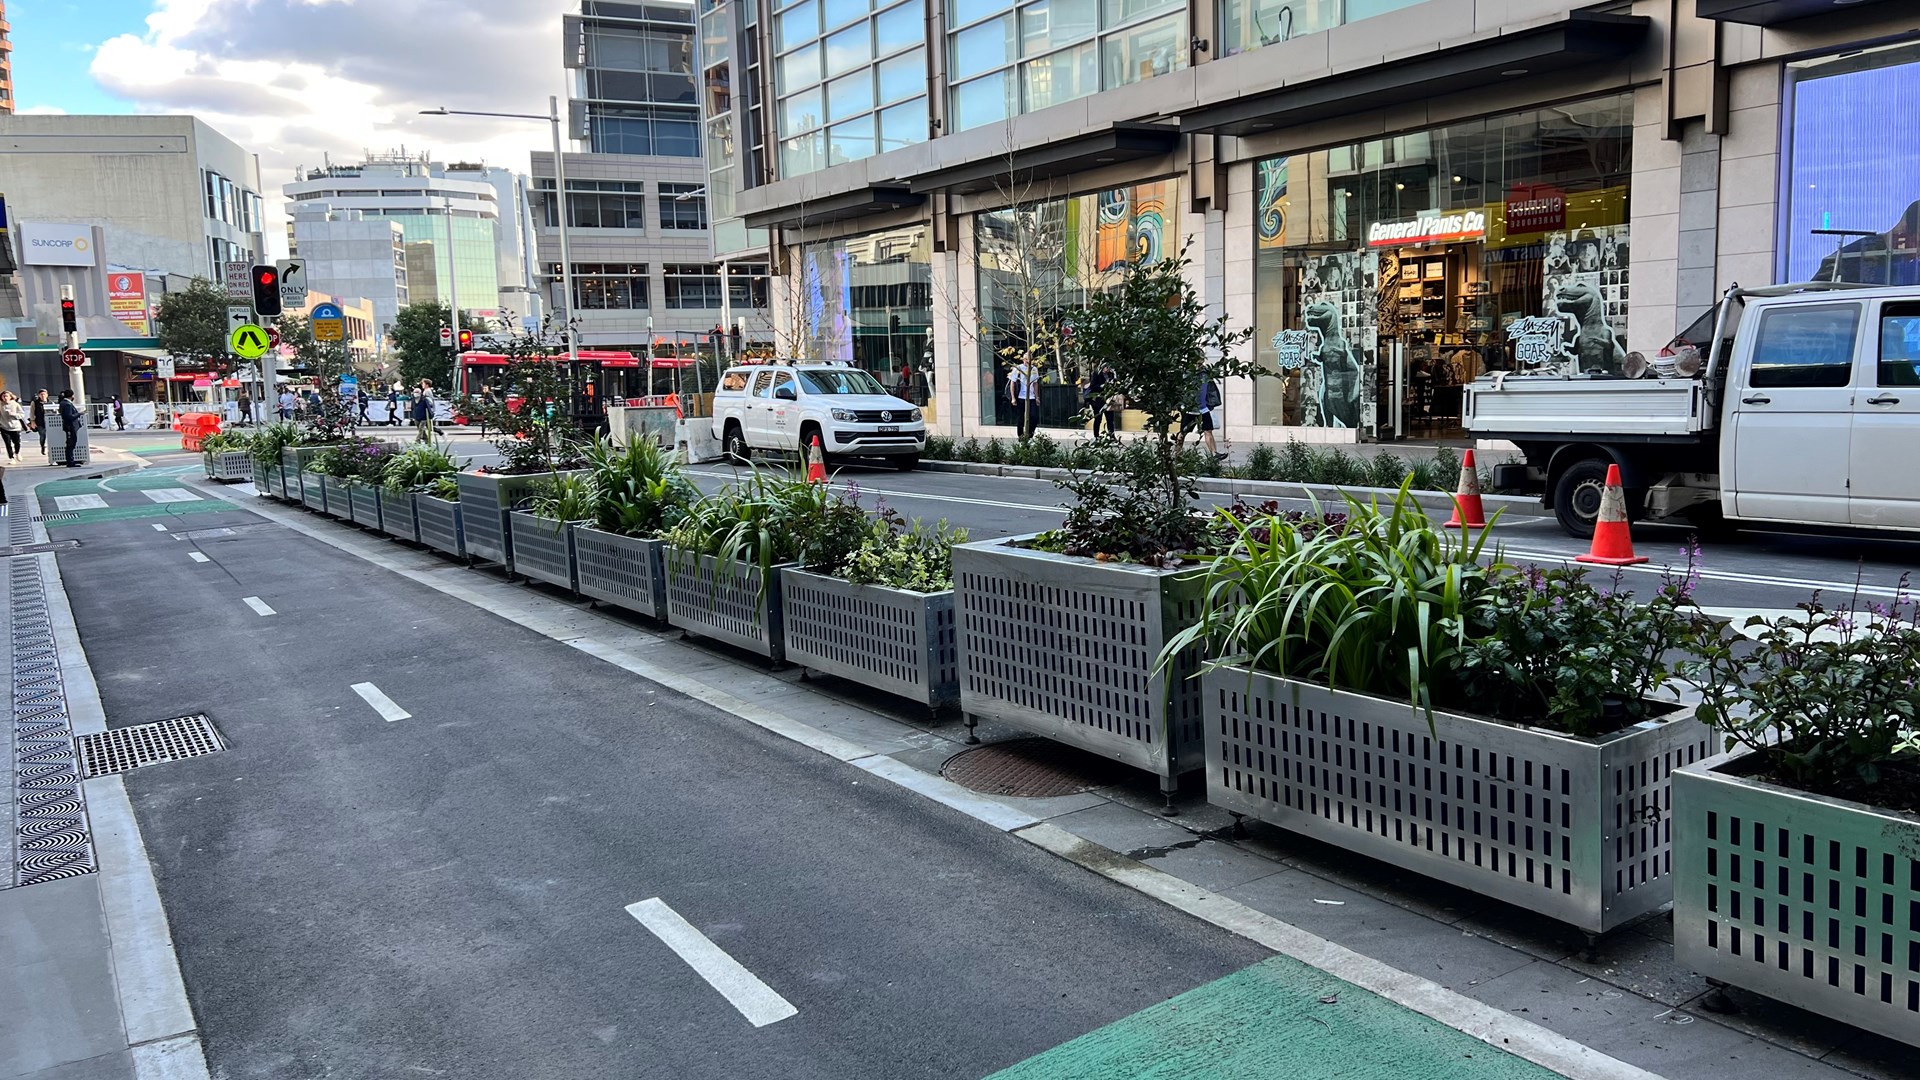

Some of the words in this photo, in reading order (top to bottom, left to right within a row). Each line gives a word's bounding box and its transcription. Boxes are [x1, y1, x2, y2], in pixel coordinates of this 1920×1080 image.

[1369, 218, 1421, 241] General
[1421, 215, 1463, 236] Pants
[1462, 211, 1485, 232] Co.
[32, 239, 73, 248] SUNCORP
[281, 286, 305, 294] ONLY
